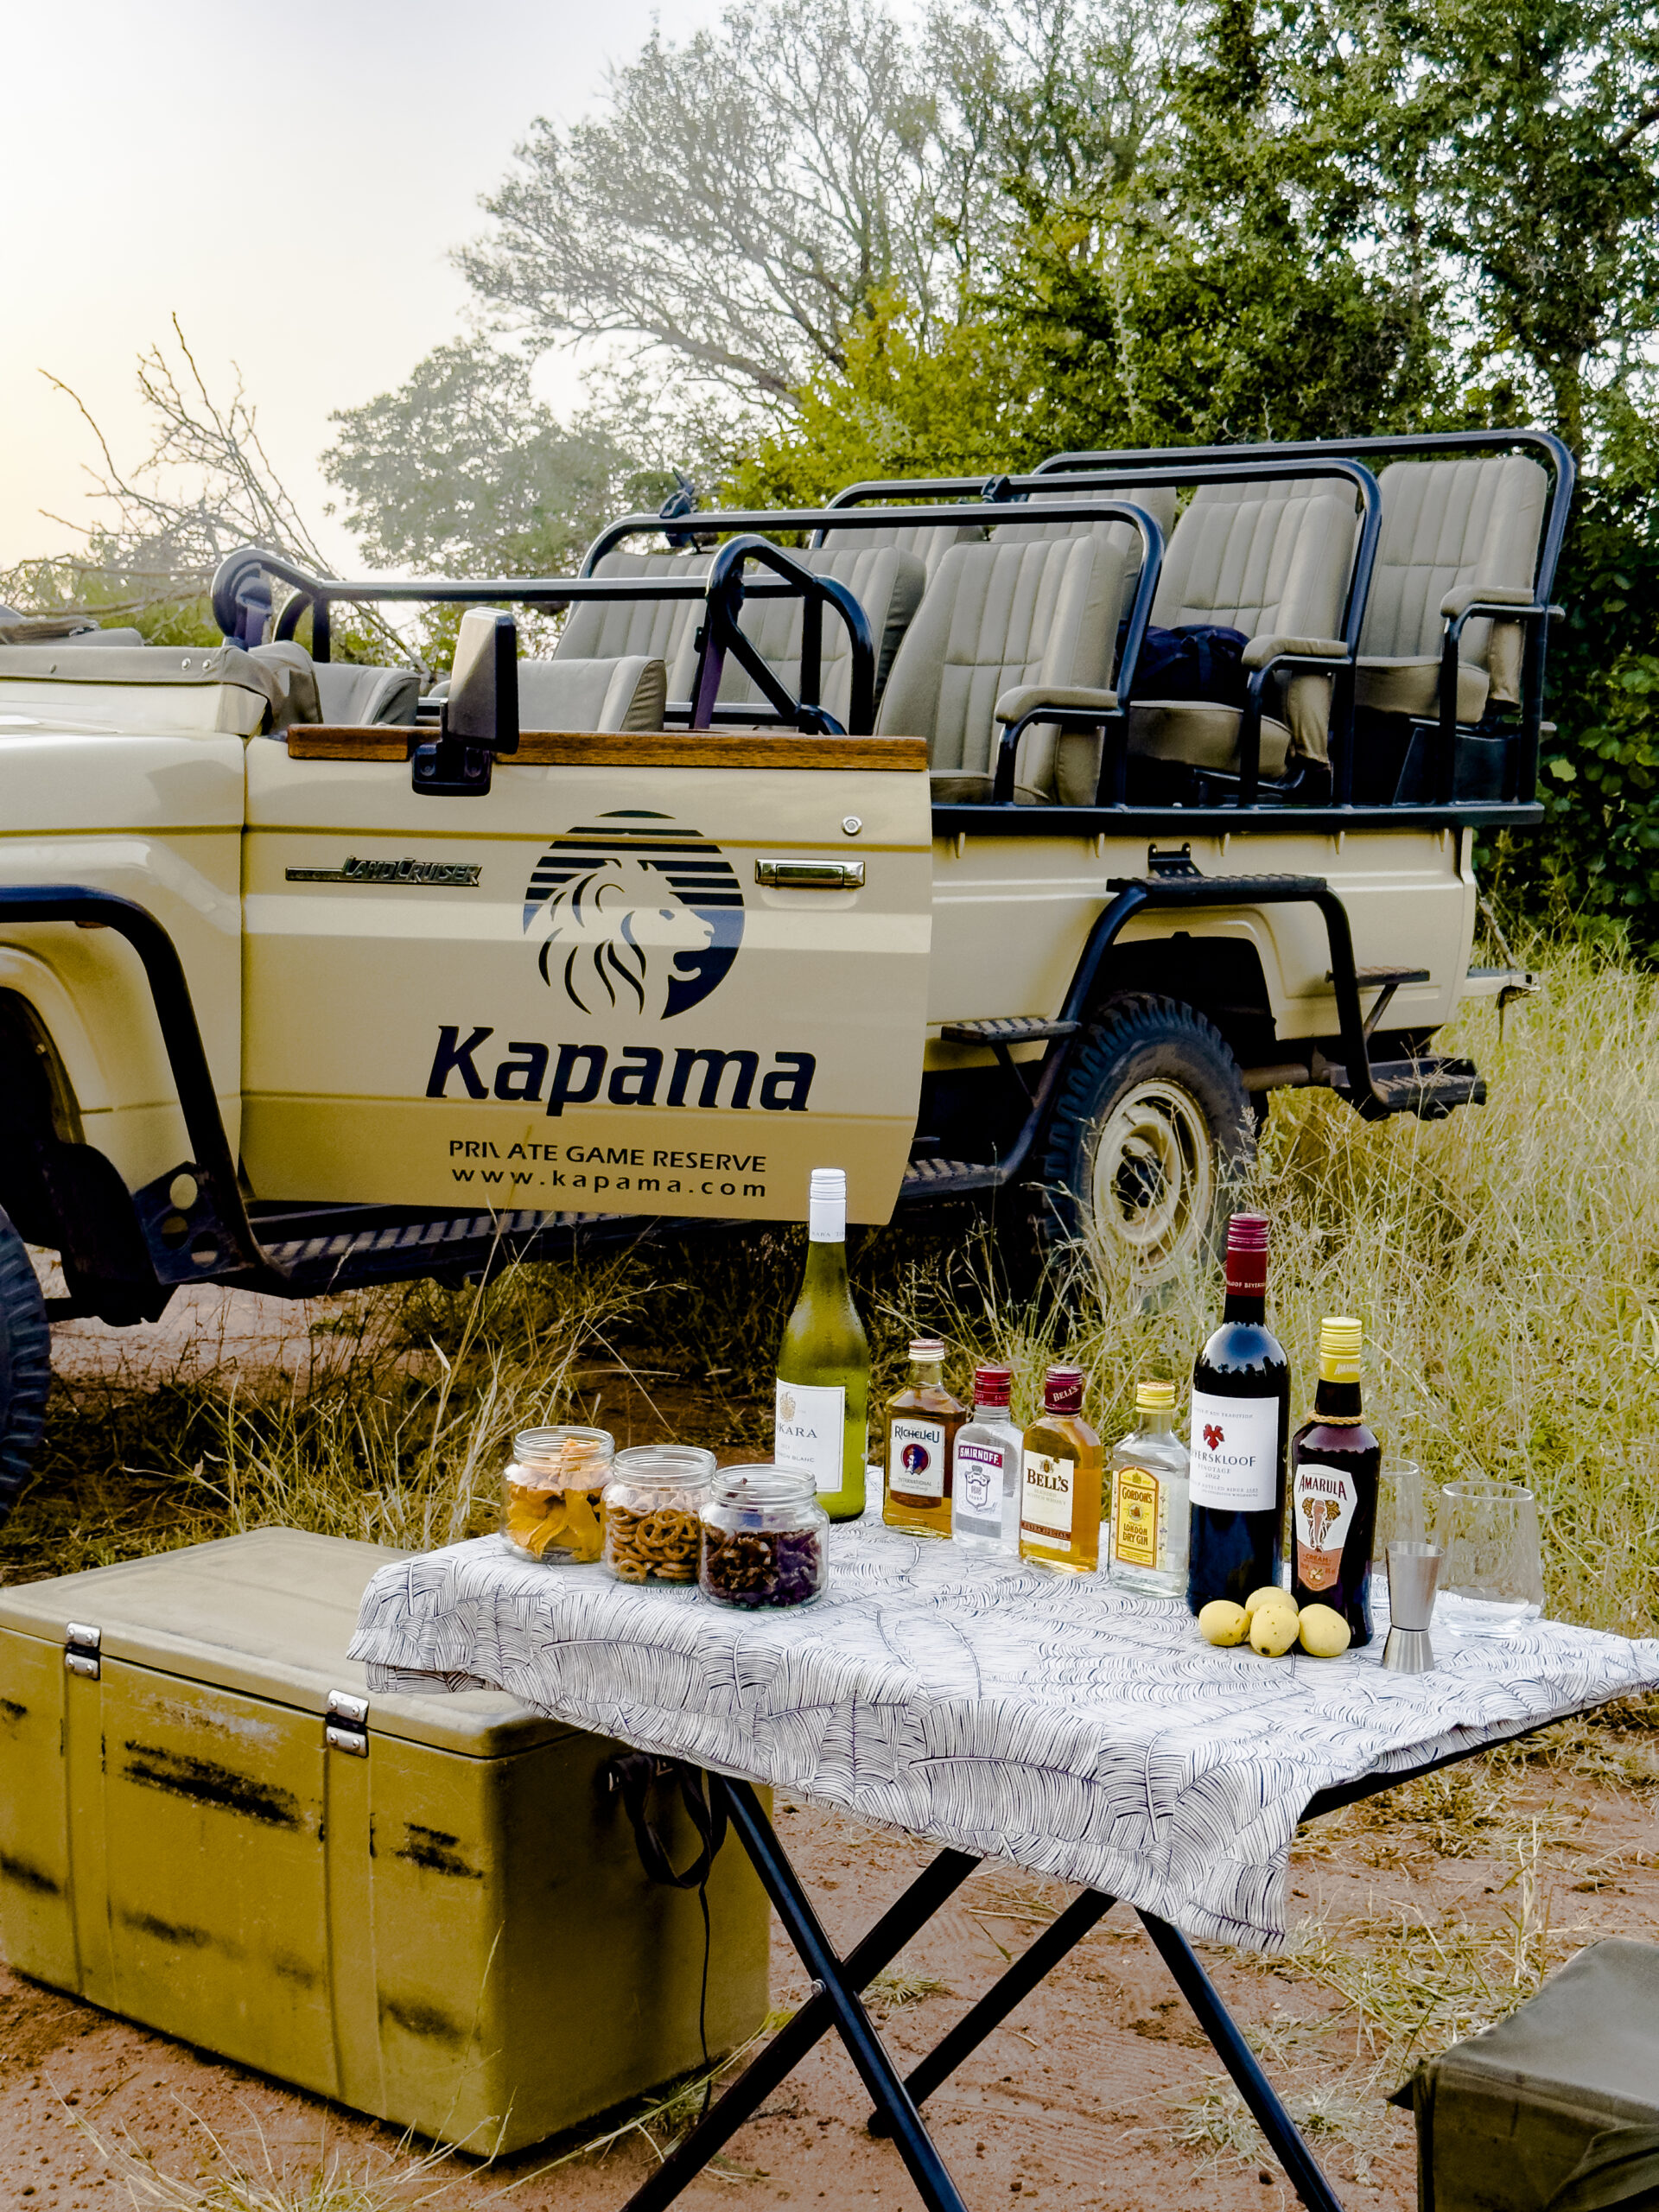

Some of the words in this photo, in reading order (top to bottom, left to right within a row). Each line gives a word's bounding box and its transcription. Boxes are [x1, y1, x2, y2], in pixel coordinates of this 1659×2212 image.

[426, 1025, 817, 1116] Kapama
[567, 1145, 645, 1166] GAME
[653, 1150, 766, 1173] RESERVE
[452, 1168, 766, 1198] www.kapama.com
[1052, 1386, 1078, 1402] BELL'S
[894, 1425, 940, 1444] RICHELIEU
[1198, 1464, 1230, 1474] PINOTAGE
[1027, 1468, 1069, 1492] BELL'S
[1298, 1473, 1347, 1501] AMARULA
[1122, 1531, 1135, 1542] DRY
[1136, 1535, 1148, 1546] GIN
[1123, 1522, 1147, 1536] LONDON
[1306, 1554, 1329, 1563] CREAM
